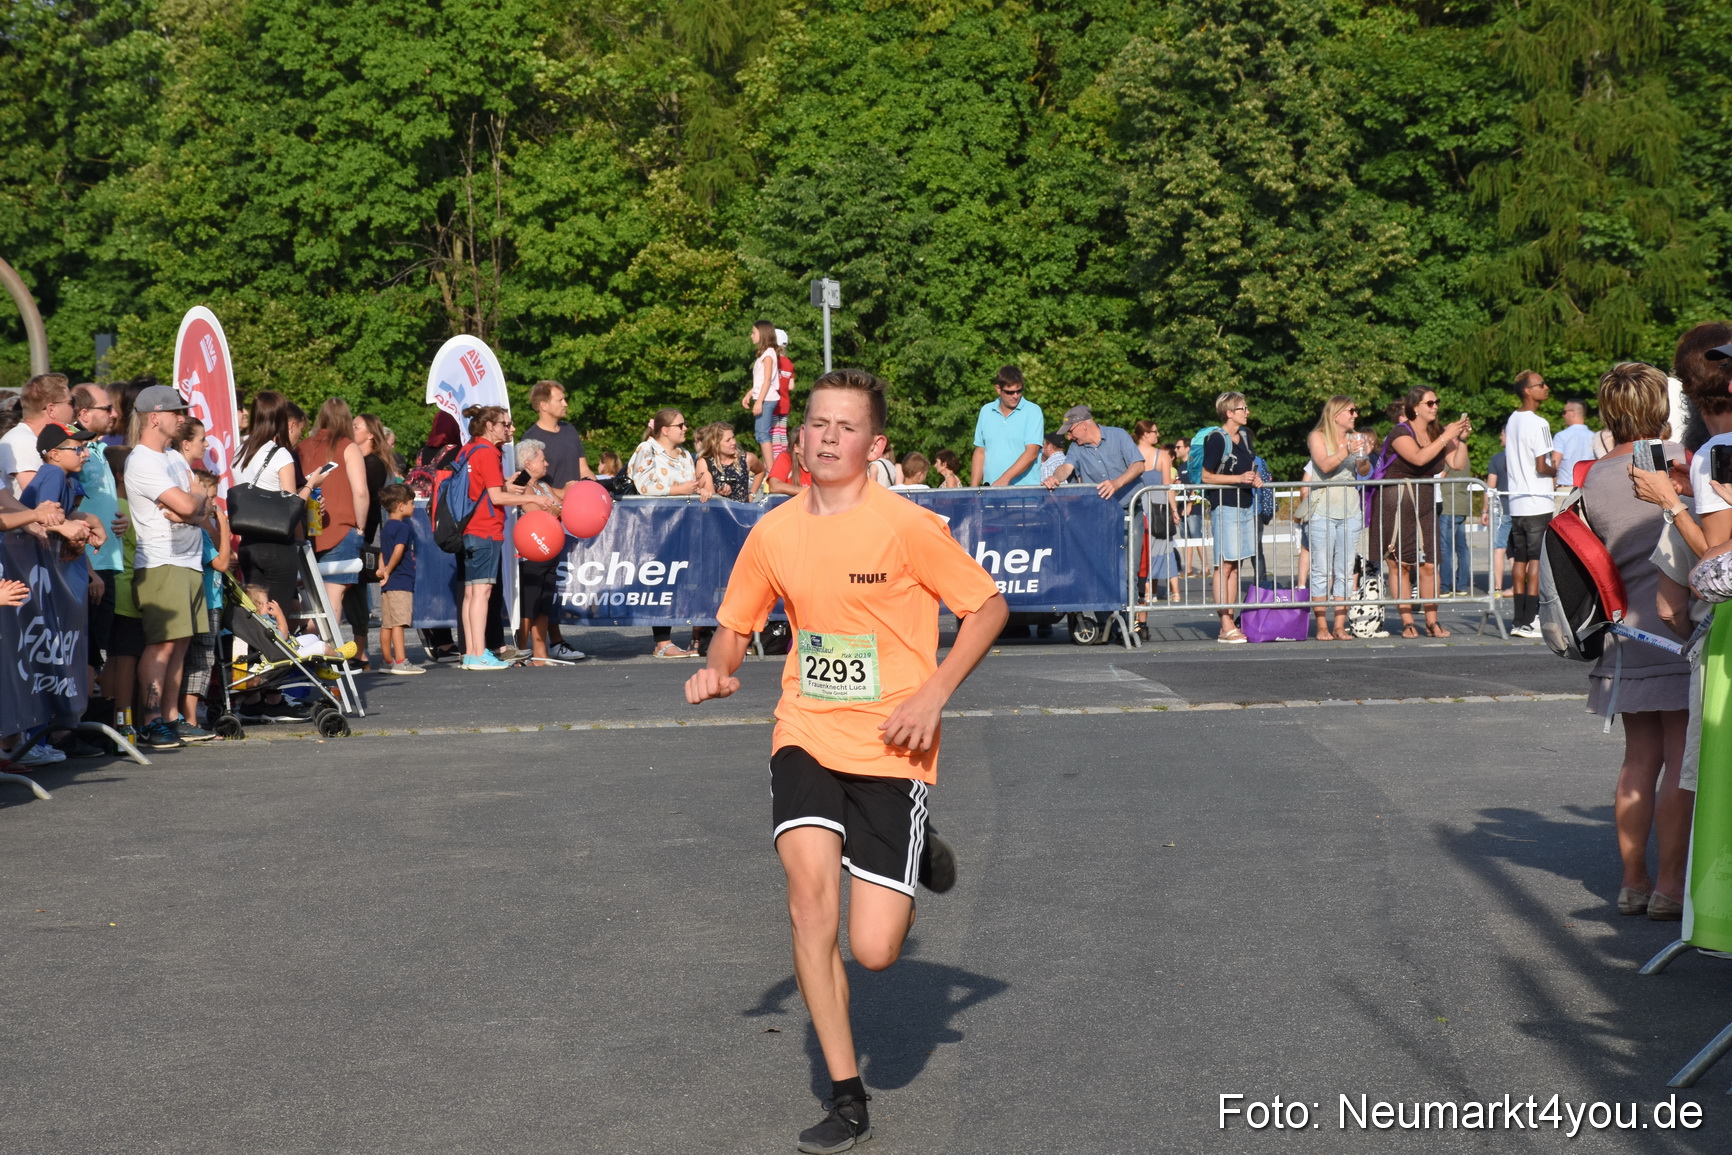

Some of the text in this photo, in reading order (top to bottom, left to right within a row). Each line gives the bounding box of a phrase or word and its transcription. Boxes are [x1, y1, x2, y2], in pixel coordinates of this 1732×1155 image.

[967, 541, 1053, 574] her
[848, 572, 887, 584] THULE
[805, 655, 866, 683] 2293
[808, 680, 848, 691] Frauenknecht
